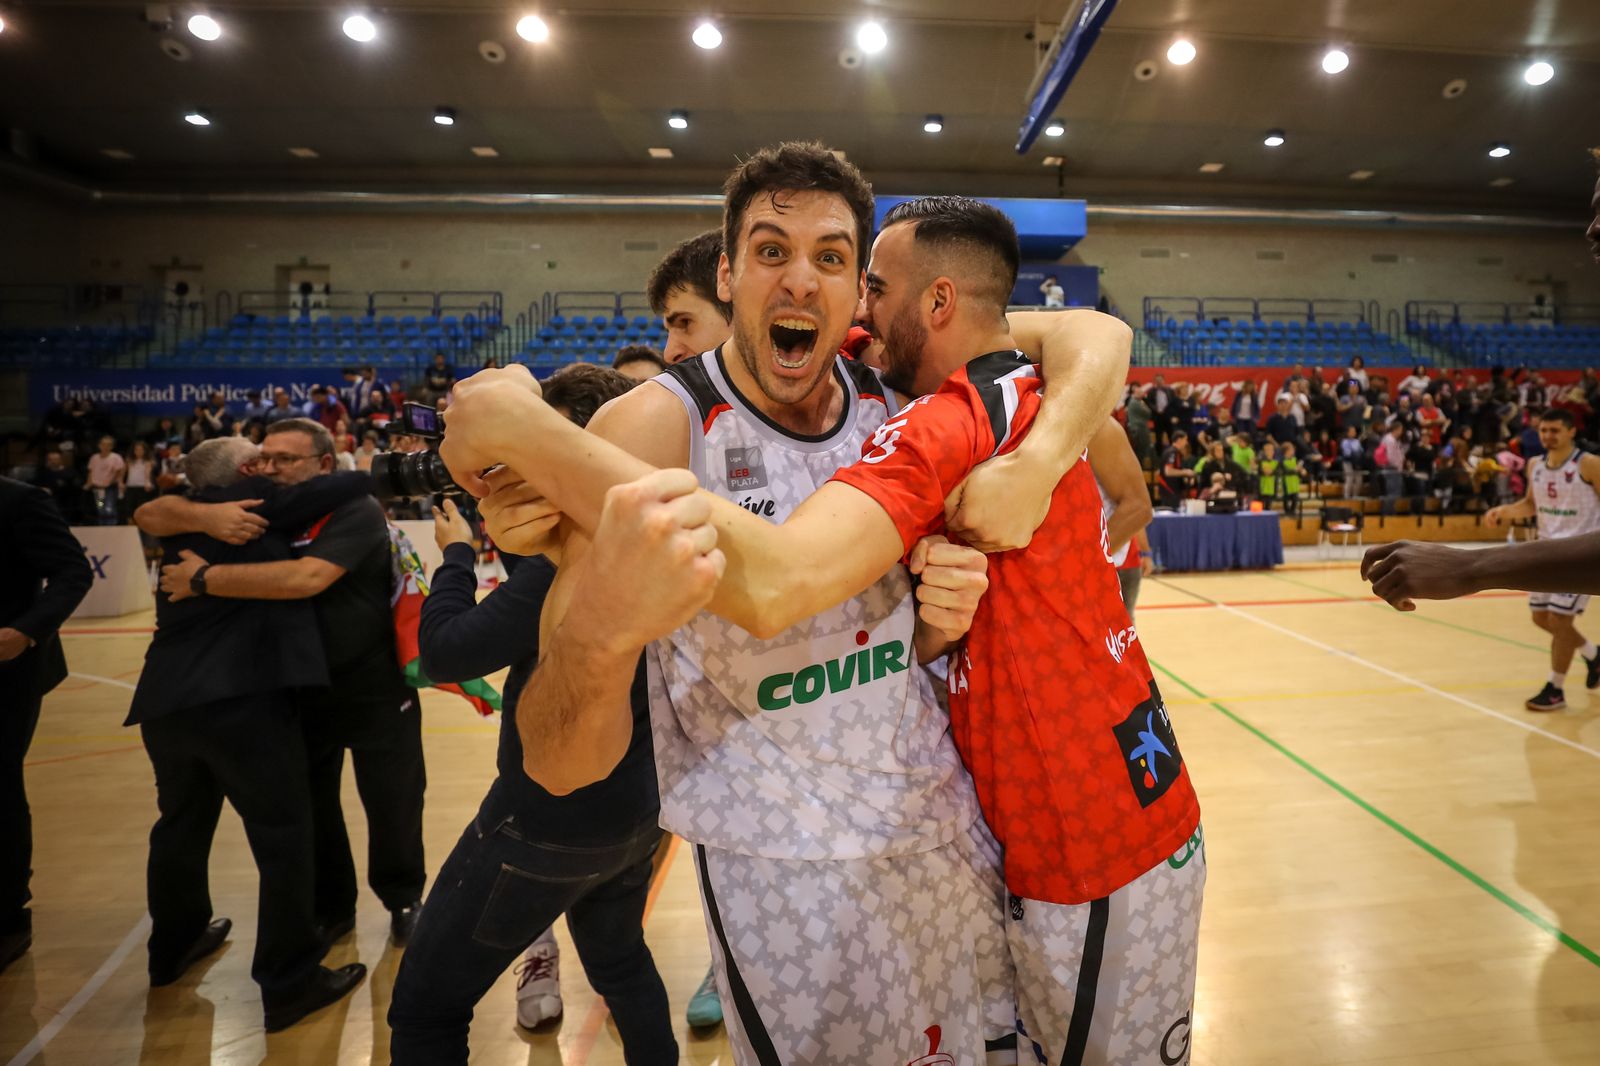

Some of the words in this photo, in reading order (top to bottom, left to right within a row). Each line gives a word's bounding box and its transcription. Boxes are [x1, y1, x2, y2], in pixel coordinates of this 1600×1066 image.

[53, 384, 175, 402] Universidad
[729, 467, 750, 479] LEB
[730, 477, 759, 487] PLATA
[757, 630, 912, 711] COVIR
